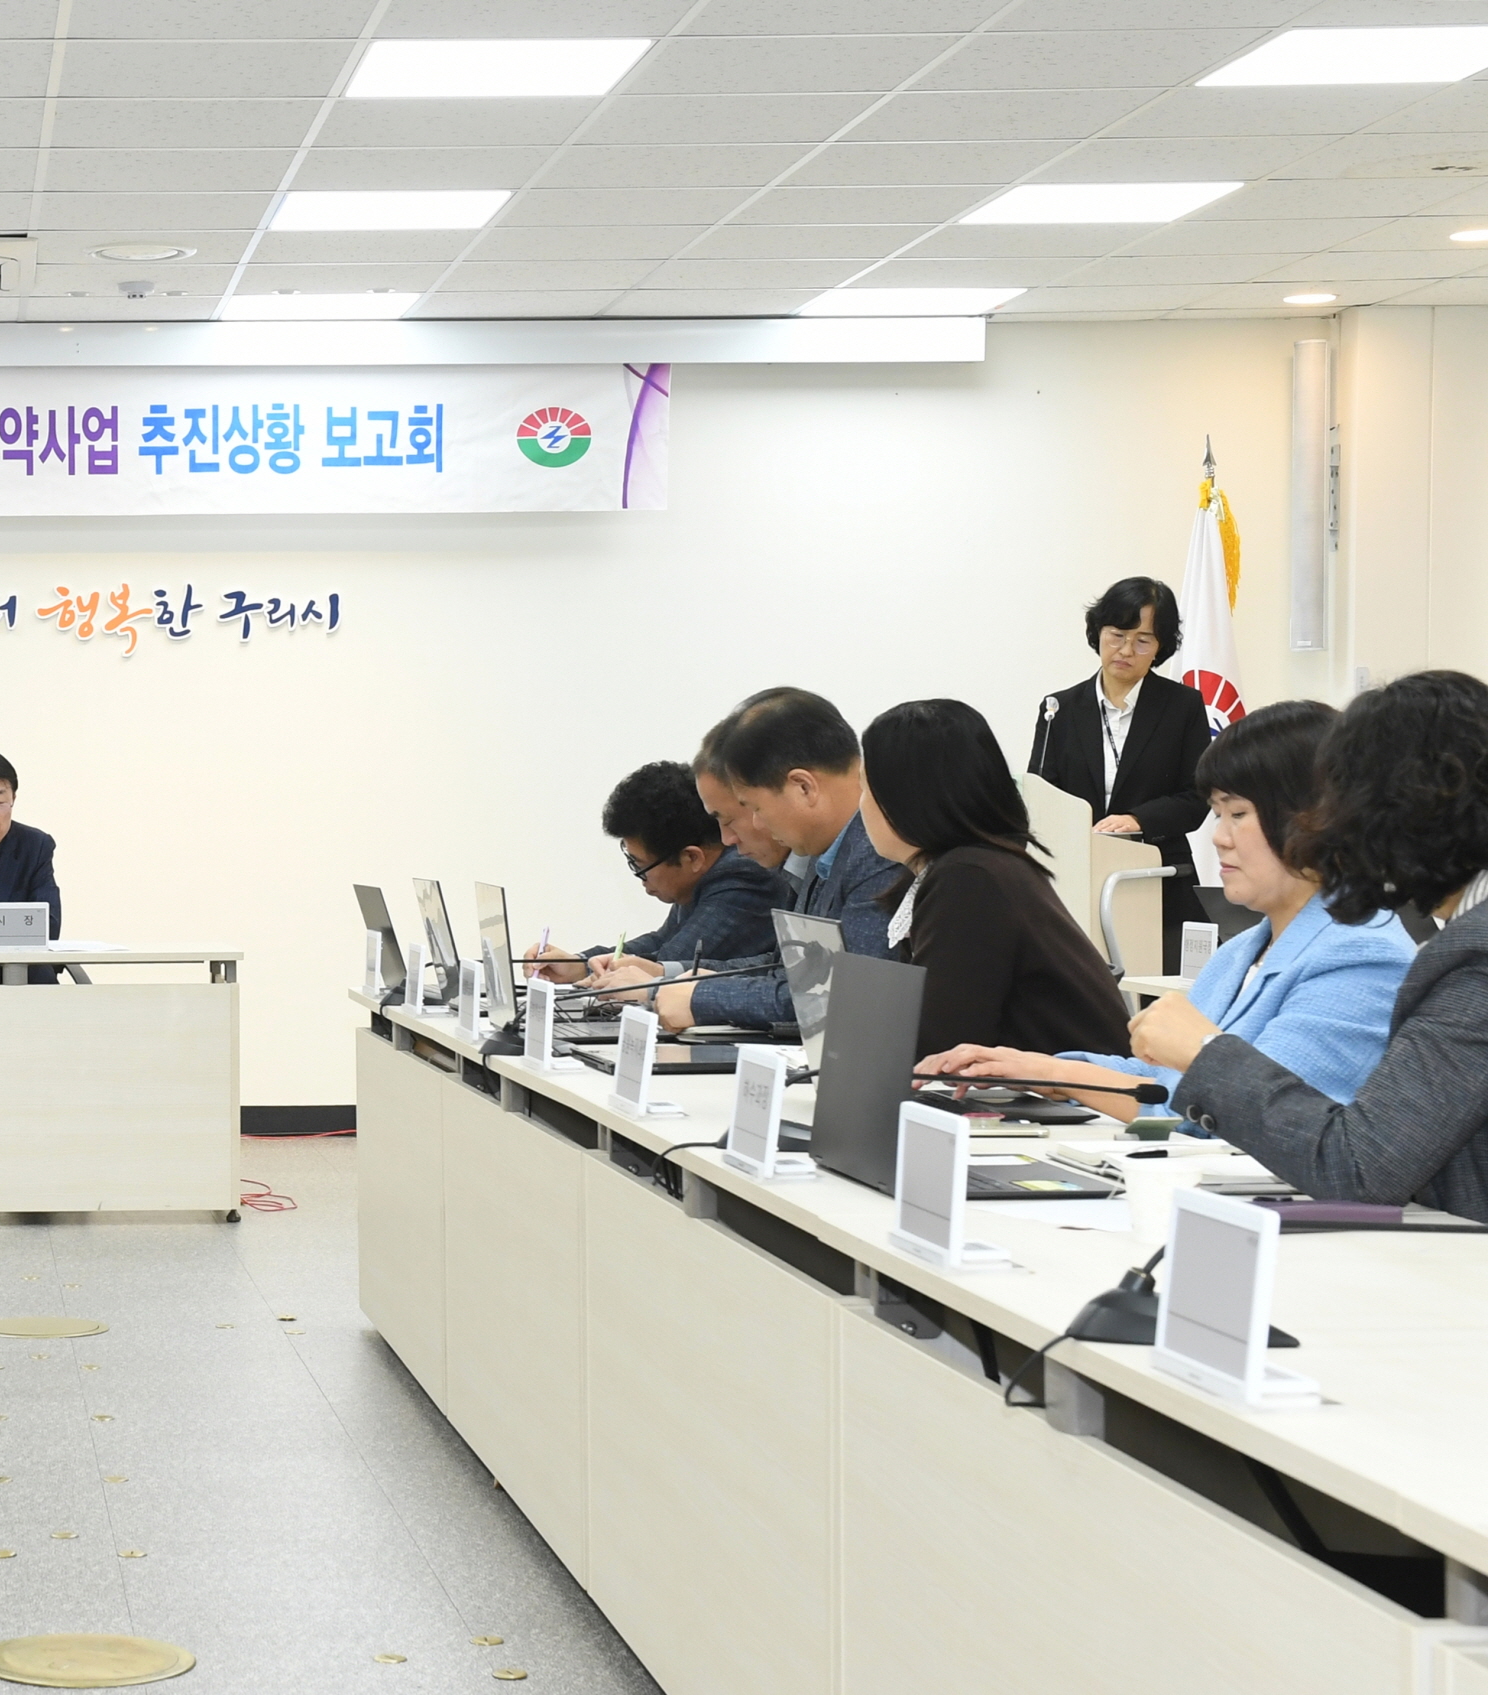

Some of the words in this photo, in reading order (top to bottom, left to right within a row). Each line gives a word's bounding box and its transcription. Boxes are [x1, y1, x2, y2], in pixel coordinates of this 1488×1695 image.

[138, 403, 305, 476] 추진상황
[321, 403, 444, 475] 보고회
[37, 583, 203, 654] 행복한
[219, 591, 339, 639] 구리시
